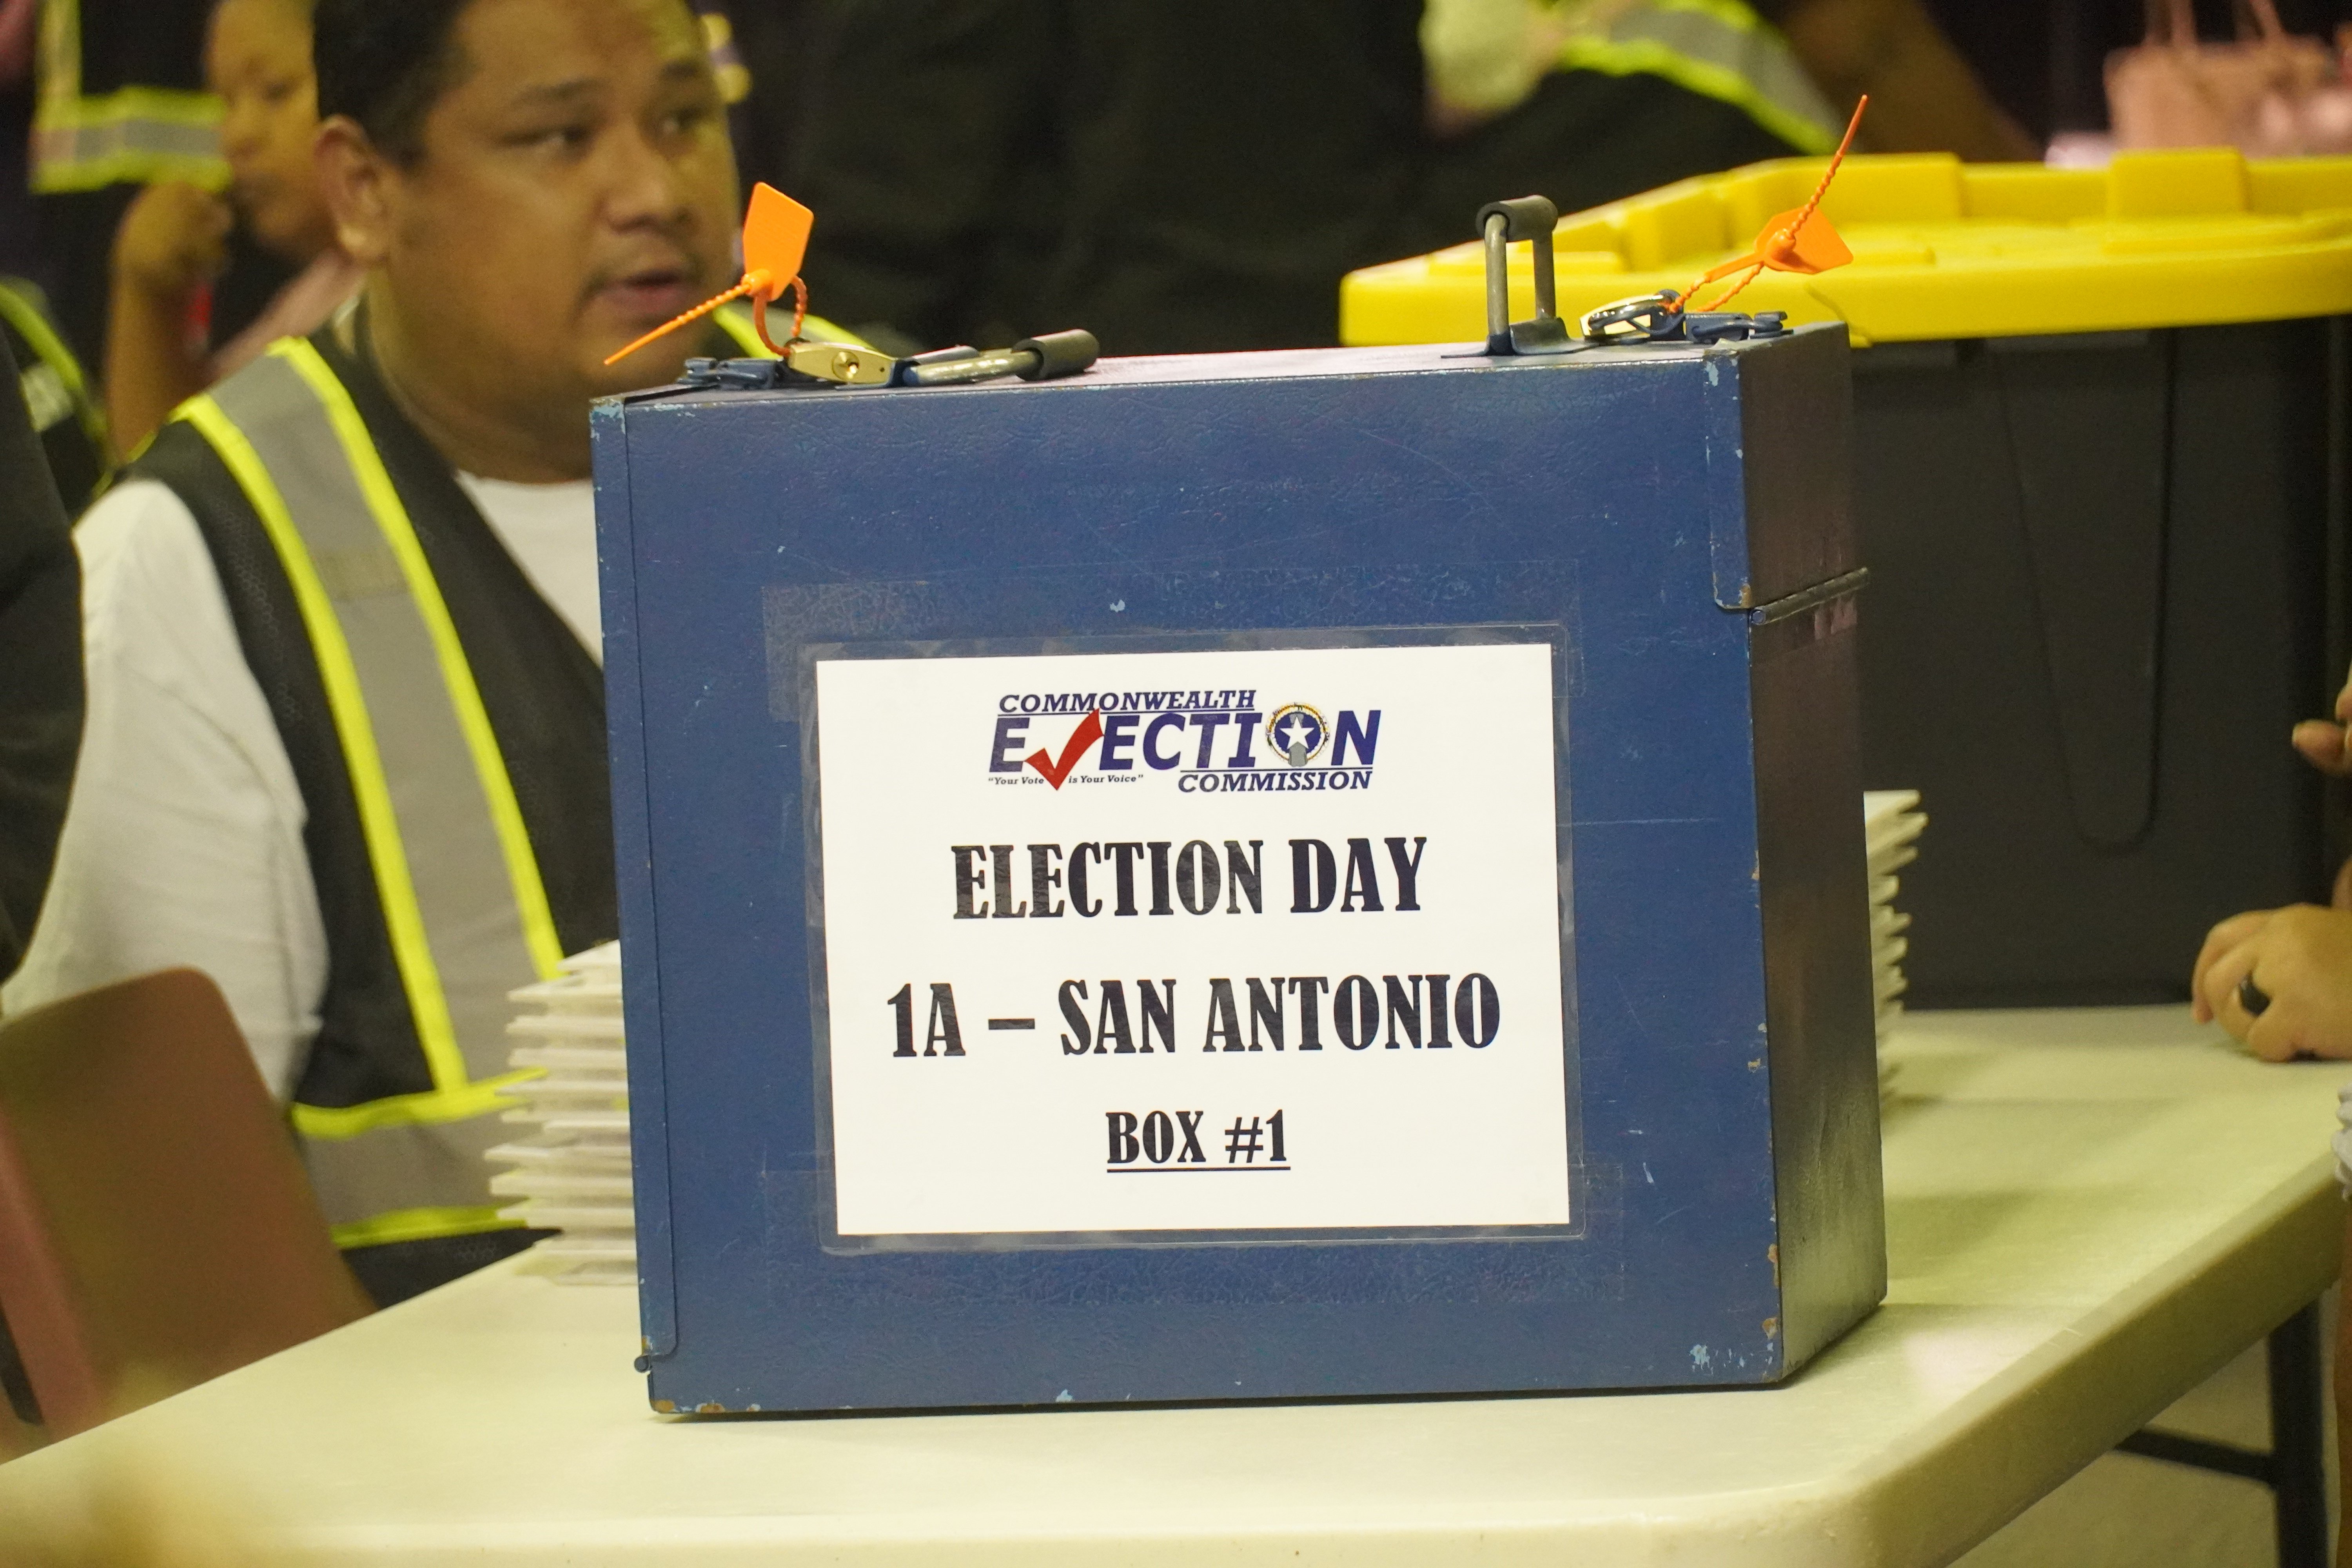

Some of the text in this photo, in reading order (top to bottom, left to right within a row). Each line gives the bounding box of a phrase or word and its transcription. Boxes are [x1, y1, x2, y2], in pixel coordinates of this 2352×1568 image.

[999, 690, 1257, 713] COMMONWEALTH
[1178, 770, 1374, 793] COMMISSION
[951, 836, 1427, 919] ELECTION DAY
[887, 983, 966, 1058] 1A
[1058, 978, 1177, 1056] SAN
[1202, 973, 1500, 1053] ANTONIO
[1105, 1109, 1287, 1164] BOX #1
